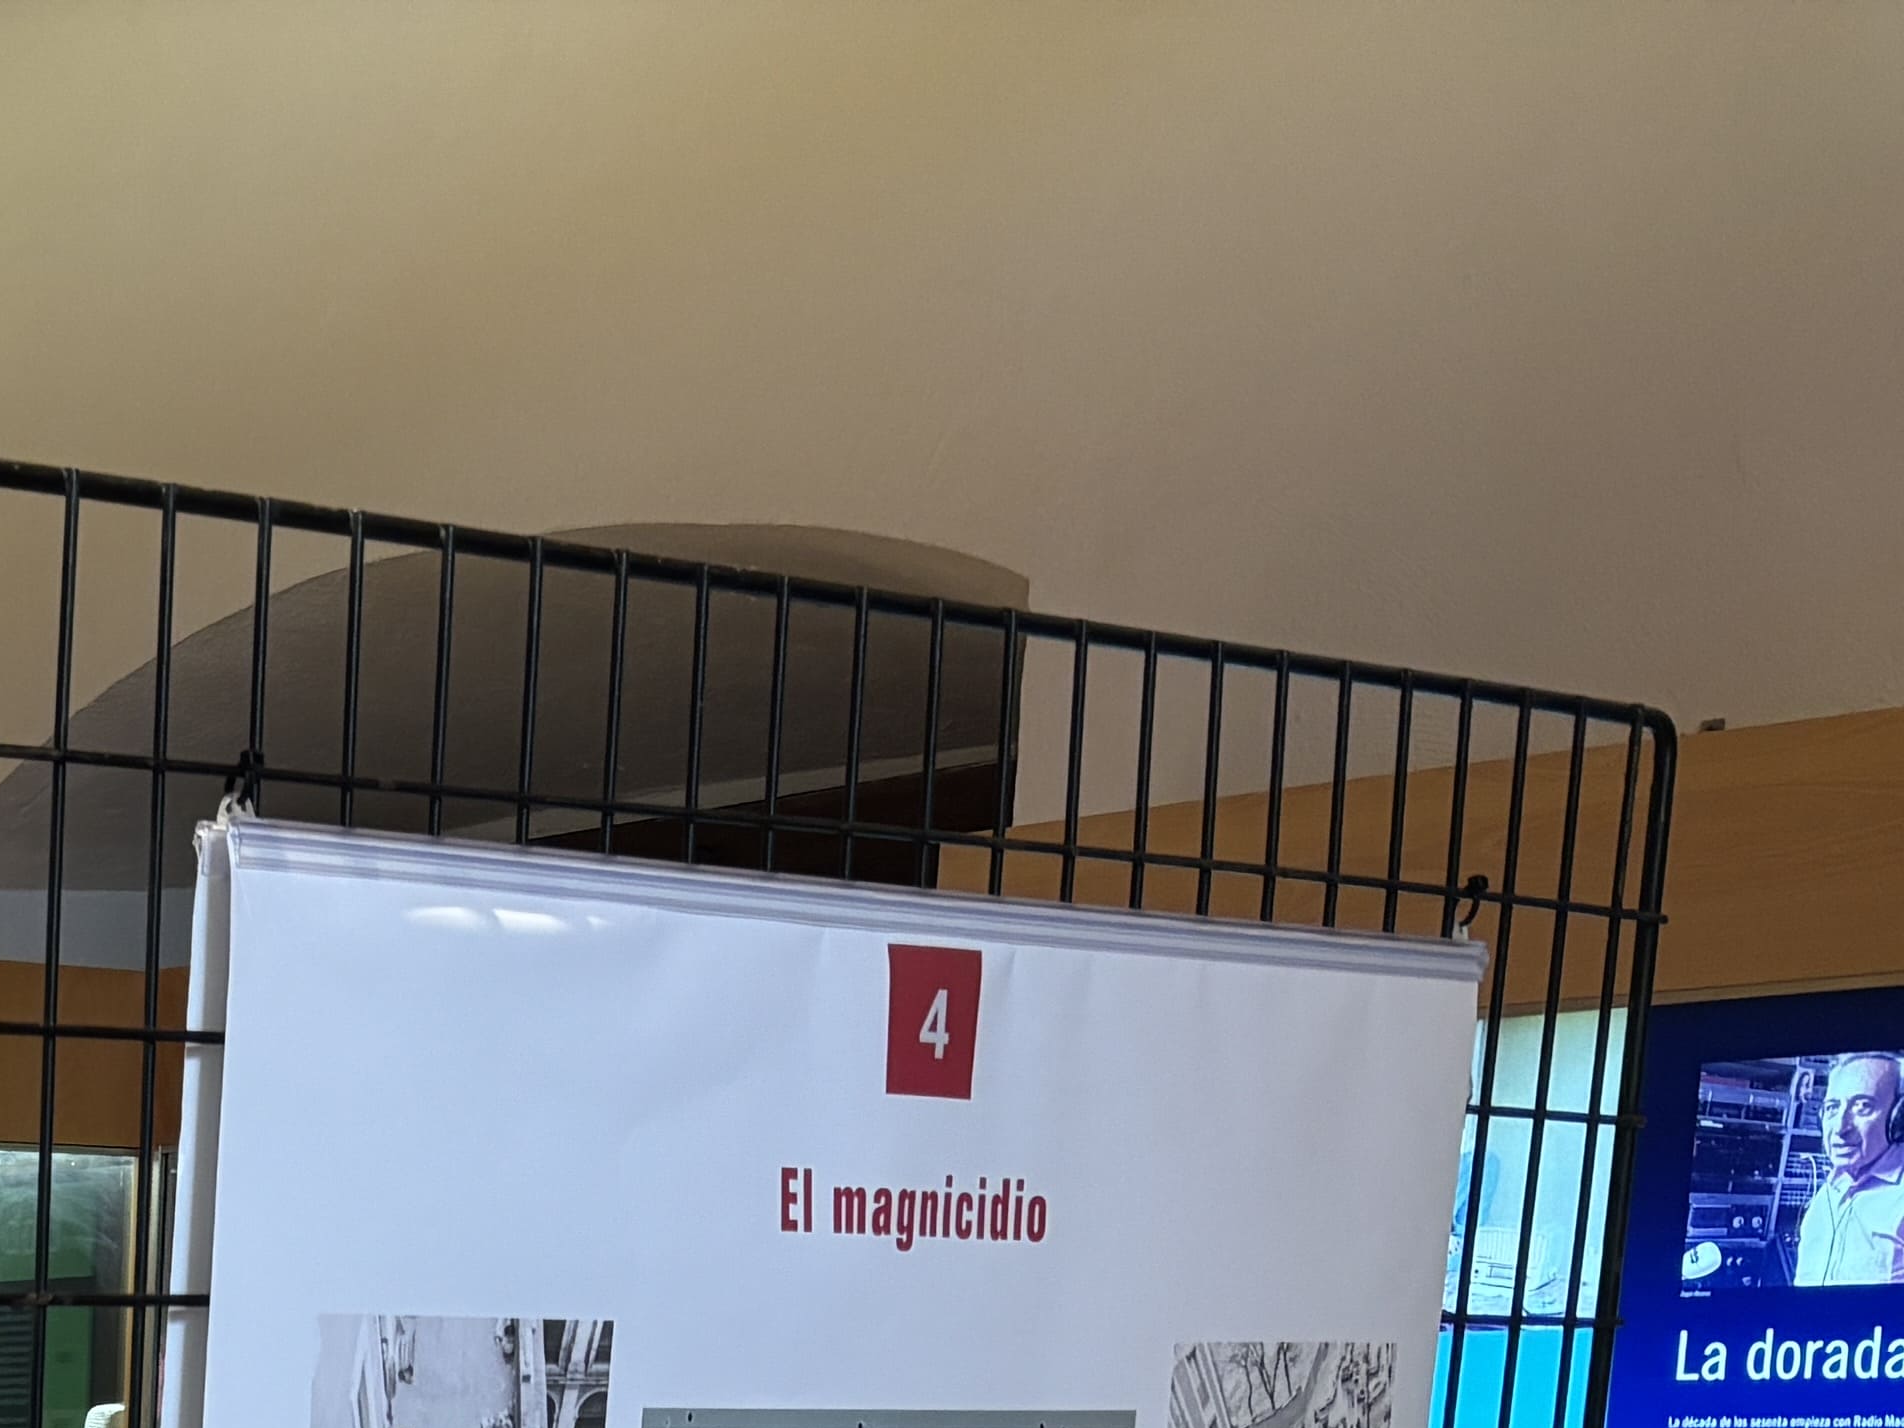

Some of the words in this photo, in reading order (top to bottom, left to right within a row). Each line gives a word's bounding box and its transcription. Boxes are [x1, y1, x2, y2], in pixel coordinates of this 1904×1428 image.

[919, 988, 950, 1060] 4
[780, 1166, 812, 1232] El
[833, 1174, 1046, 1250] magnicidio
[1676, 1330, 1726, 1381] La
[1746, 1325, 1903, 1380] dorada
